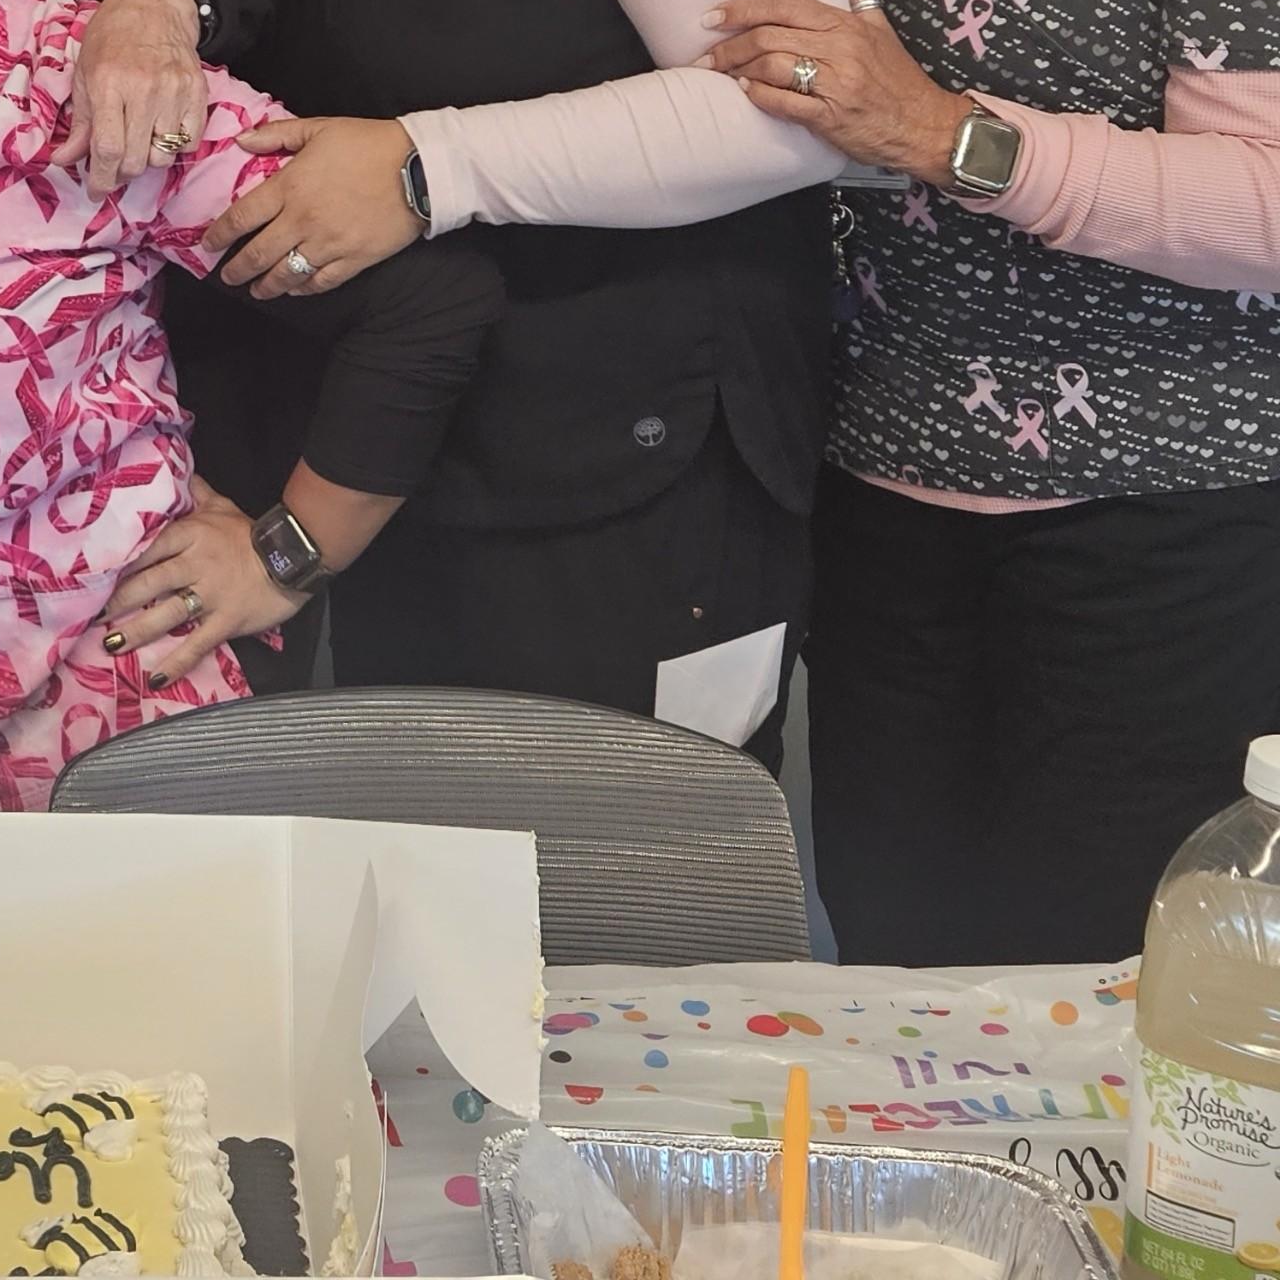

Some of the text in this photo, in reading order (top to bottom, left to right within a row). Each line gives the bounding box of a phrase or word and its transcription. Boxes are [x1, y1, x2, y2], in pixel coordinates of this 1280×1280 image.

[1176, 1106, 1278, 1150] Promise
[1184, 1086, 1277, 1132] Nature's
[1193, 1131, 1261, 1160] Organic
